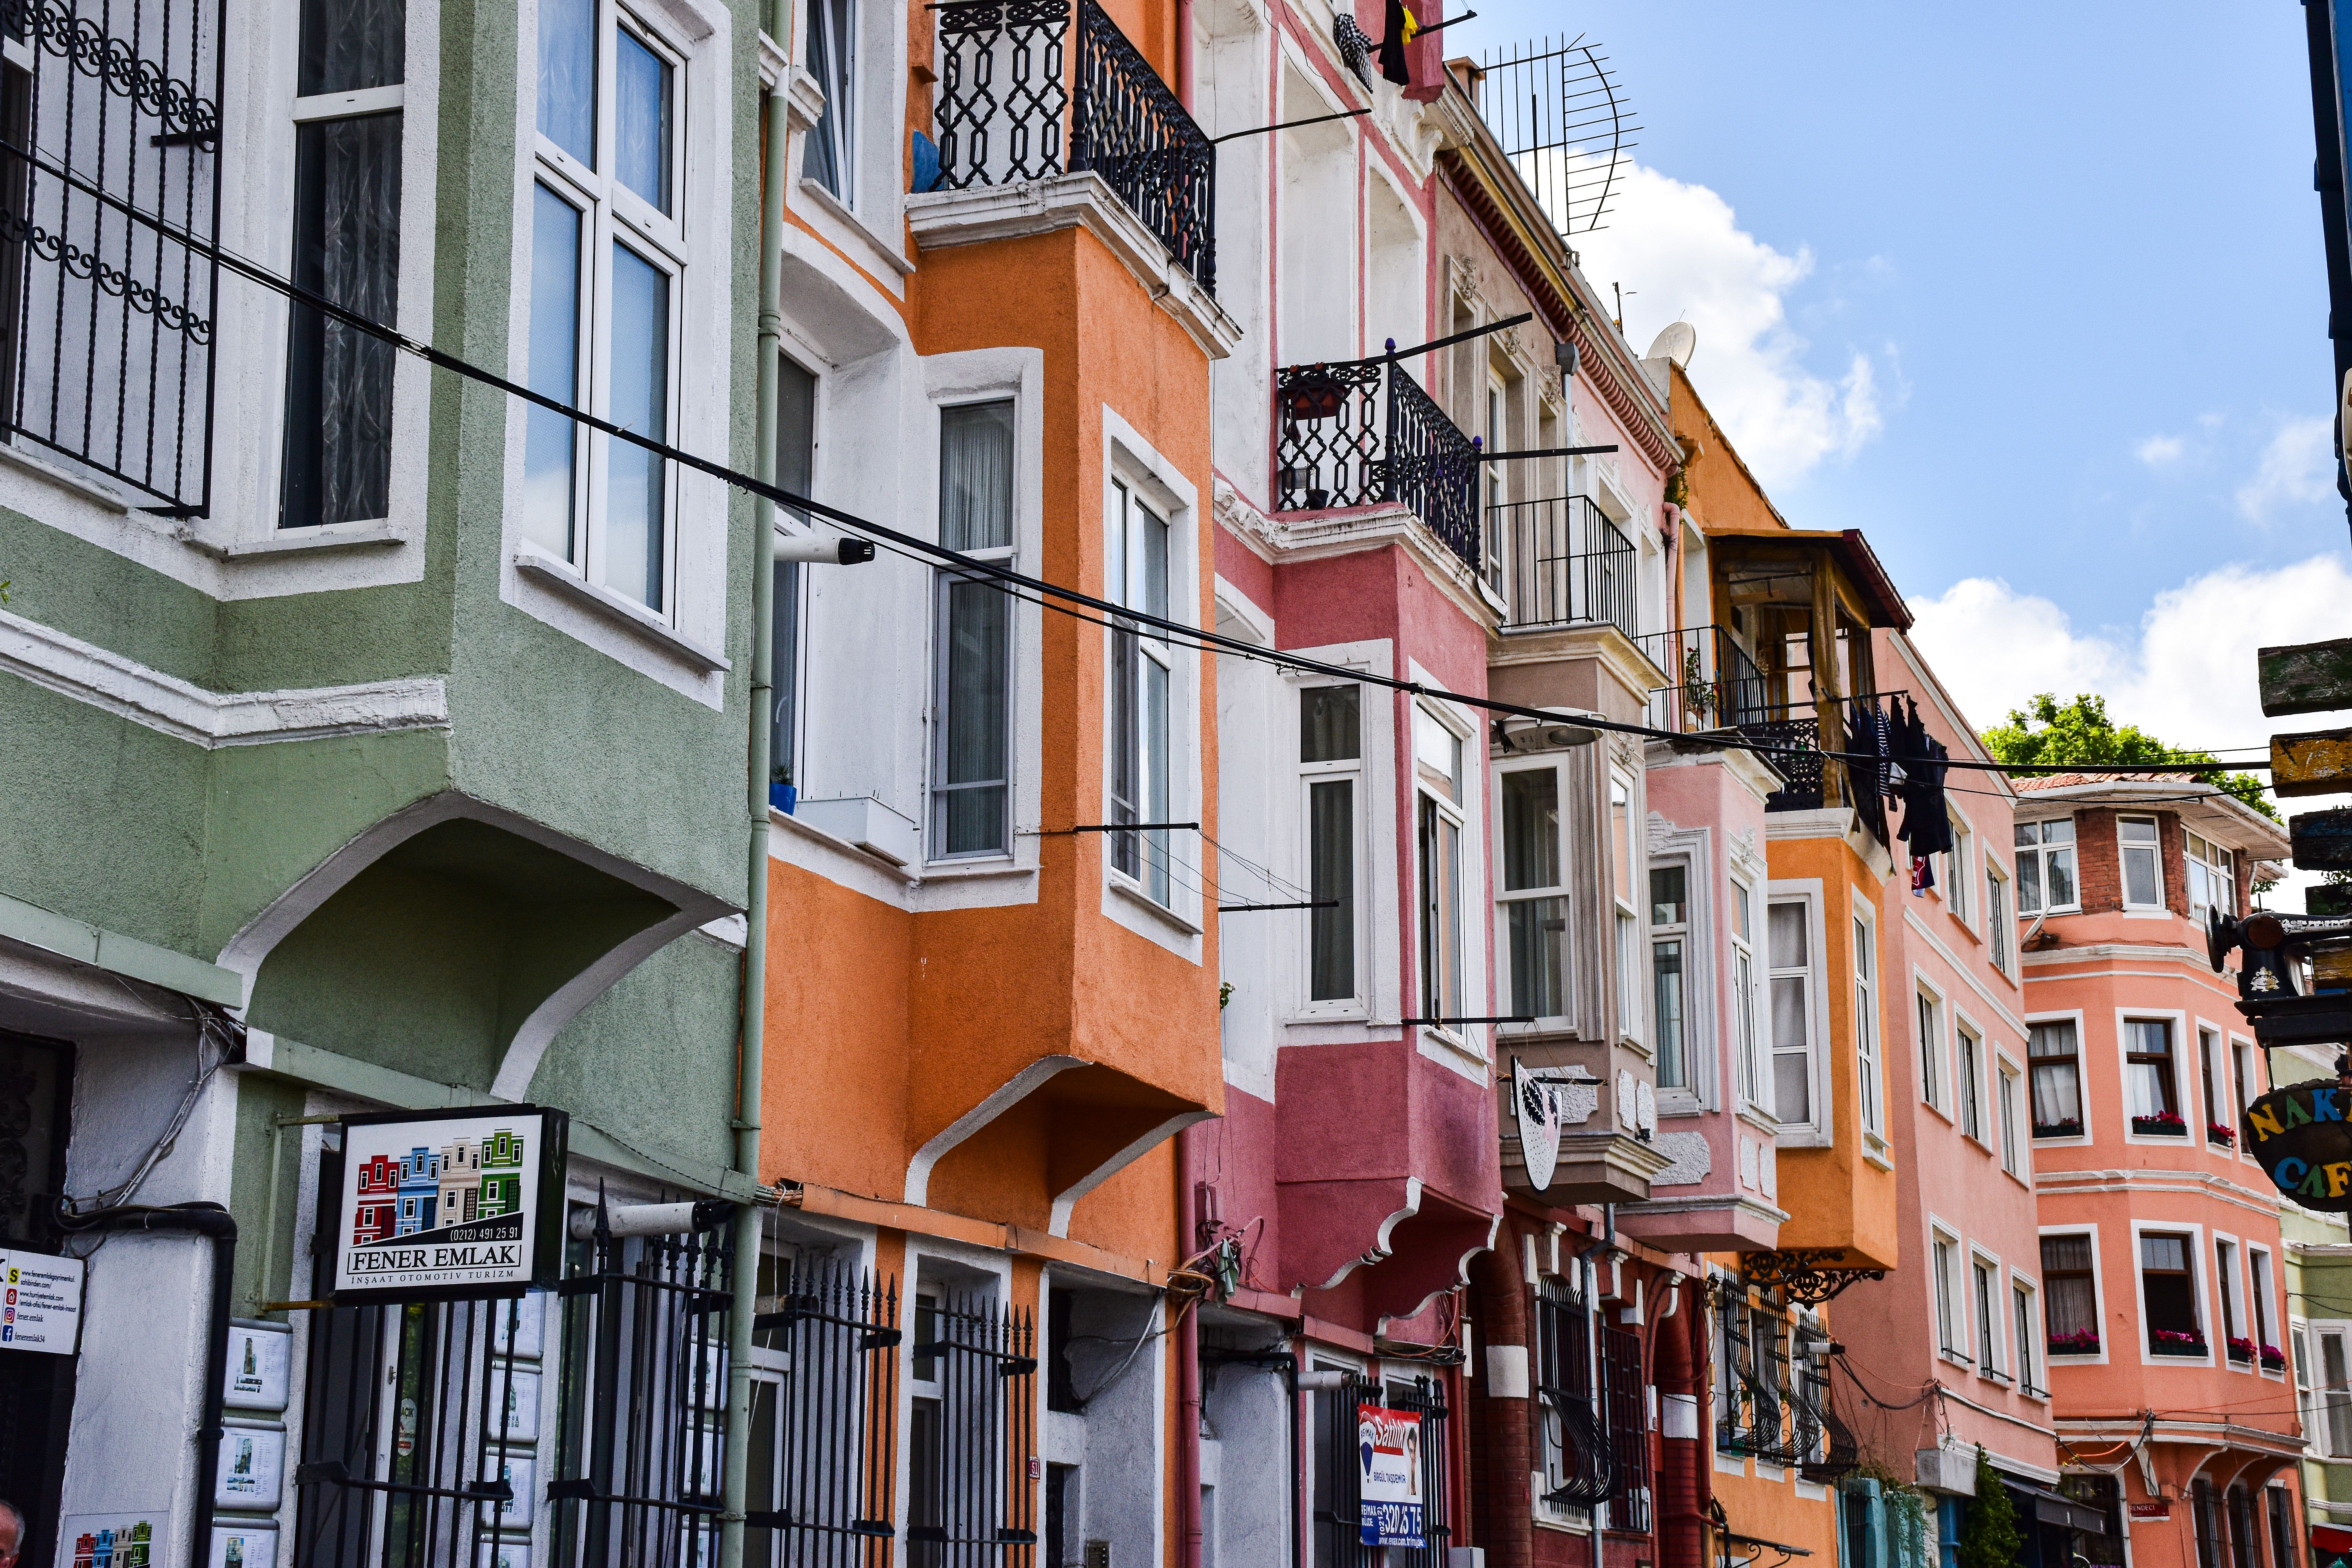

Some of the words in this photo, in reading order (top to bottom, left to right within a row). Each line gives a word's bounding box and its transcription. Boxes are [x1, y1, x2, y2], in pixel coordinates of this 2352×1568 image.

[450, 1229, 476, 1241] (0212)
[479, 1228, 493, 1238] 491
[496, 1228, 506, 1238] 25
[510, 1227, 517, 1238] 91
[353, 1249, 427, 1270] FENER
[433, 1245, 515, 1266] EMLAK
[351, 1275, 393, 1285] İNŞAAT
[400, 1272, 462, 1281] OTOMOTİV
[468, 1270, 514, 1279] TURİZM
[17, 1312, 44, 1322] fener.emlak
[15, 1332, 45, 1343] feneremlak34
[1032, 1462, 1038, 1474] 51
